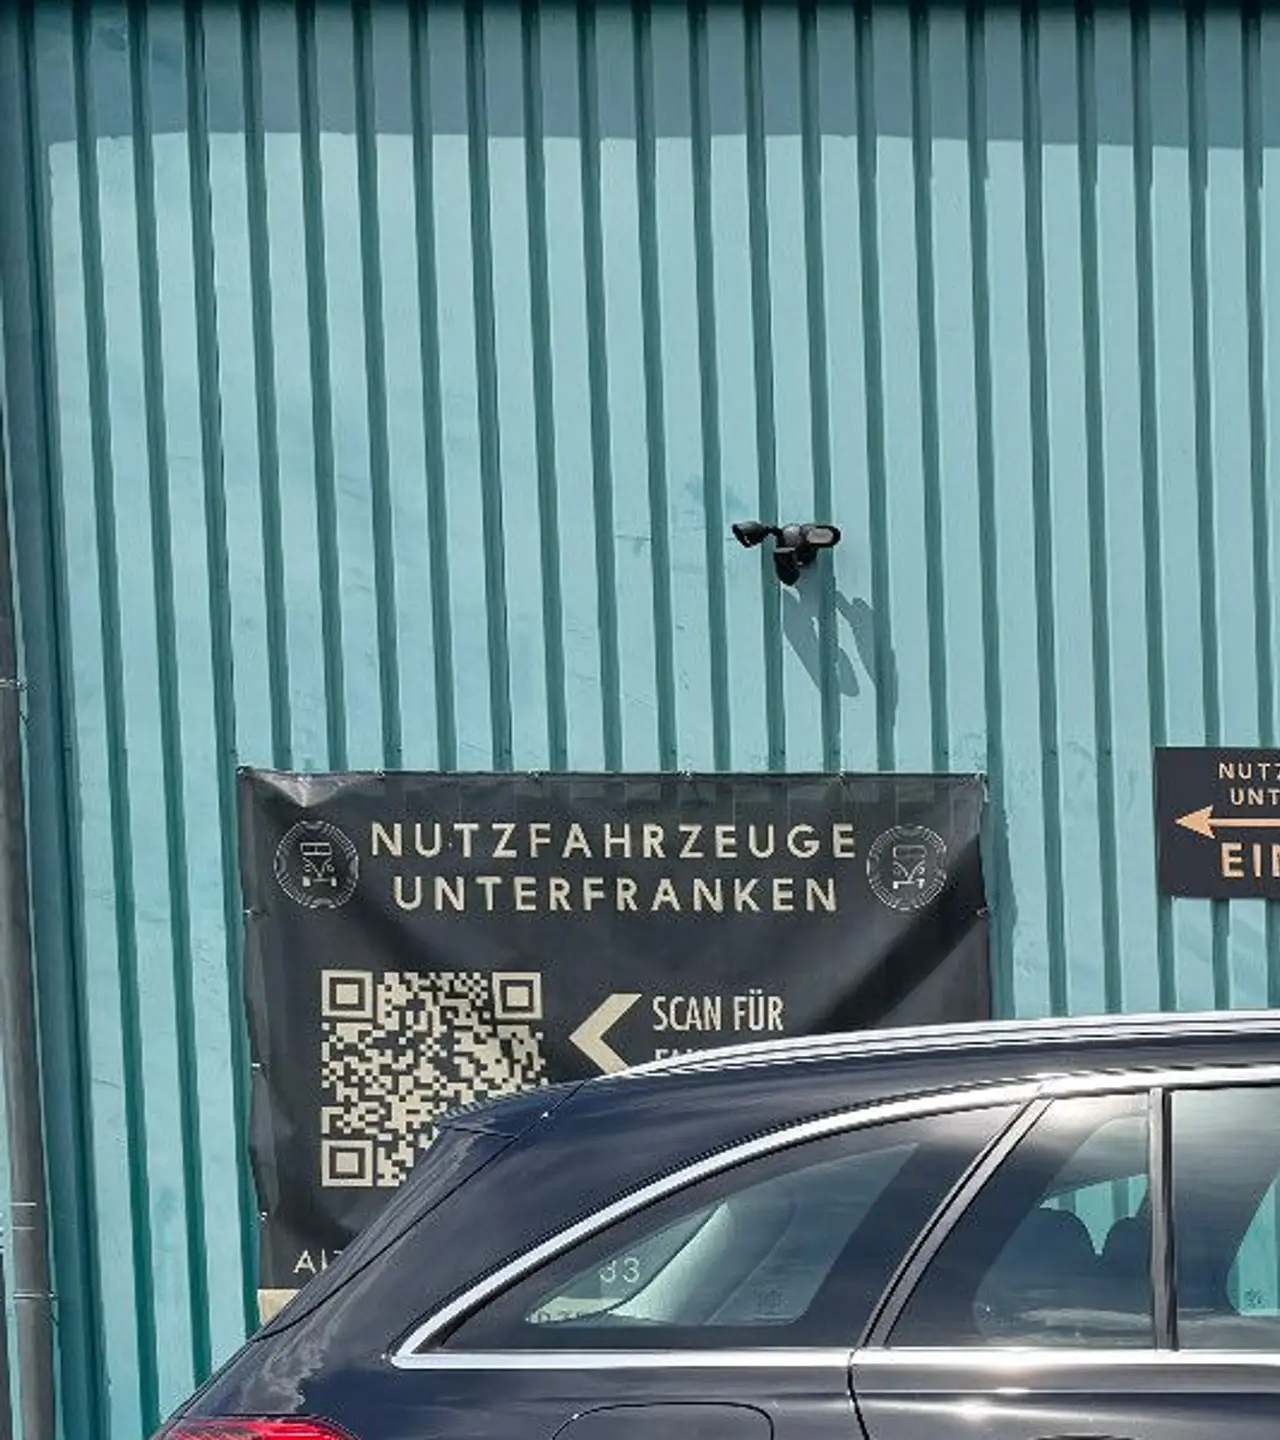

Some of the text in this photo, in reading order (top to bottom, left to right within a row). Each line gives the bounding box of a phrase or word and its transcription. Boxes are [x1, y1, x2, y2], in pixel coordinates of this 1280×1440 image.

[370, 822, 857, 861] NUTZFAHRZEUGE
[394, 876, 839, 912] UNTERFRANKEN
[652, 988, 784, 1031] SCAN FÜR
